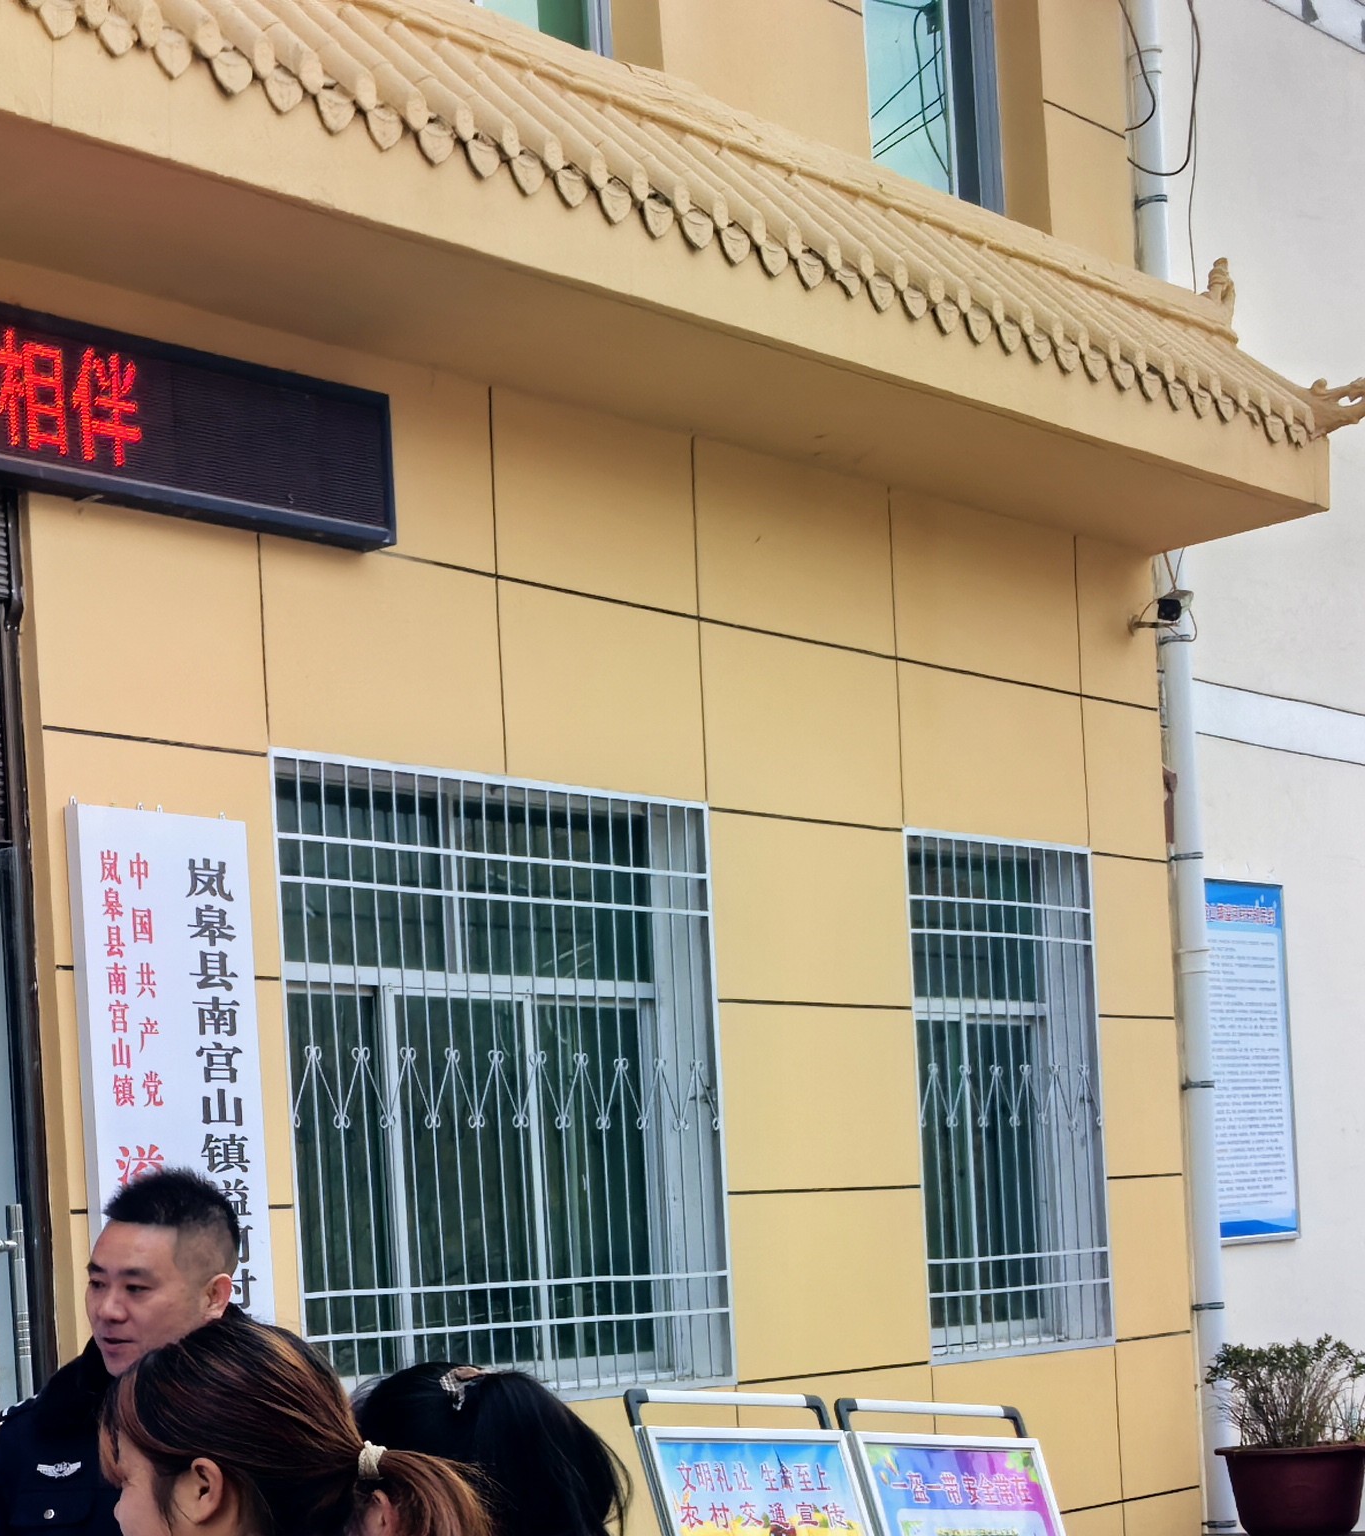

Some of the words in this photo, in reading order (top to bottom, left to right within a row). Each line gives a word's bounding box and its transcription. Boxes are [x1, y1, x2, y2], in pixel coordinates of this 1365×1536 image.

[99, 849, 136, 1108] 岚皋县南宫山镇
[129, 852, 165, 1108] 中国共产党
[677, 1461, 753, 1494] 文明礼让
[760, 1463, 832, 1493] 生命至上
[680, 1501, 851, 1531] 农村交通宣传
